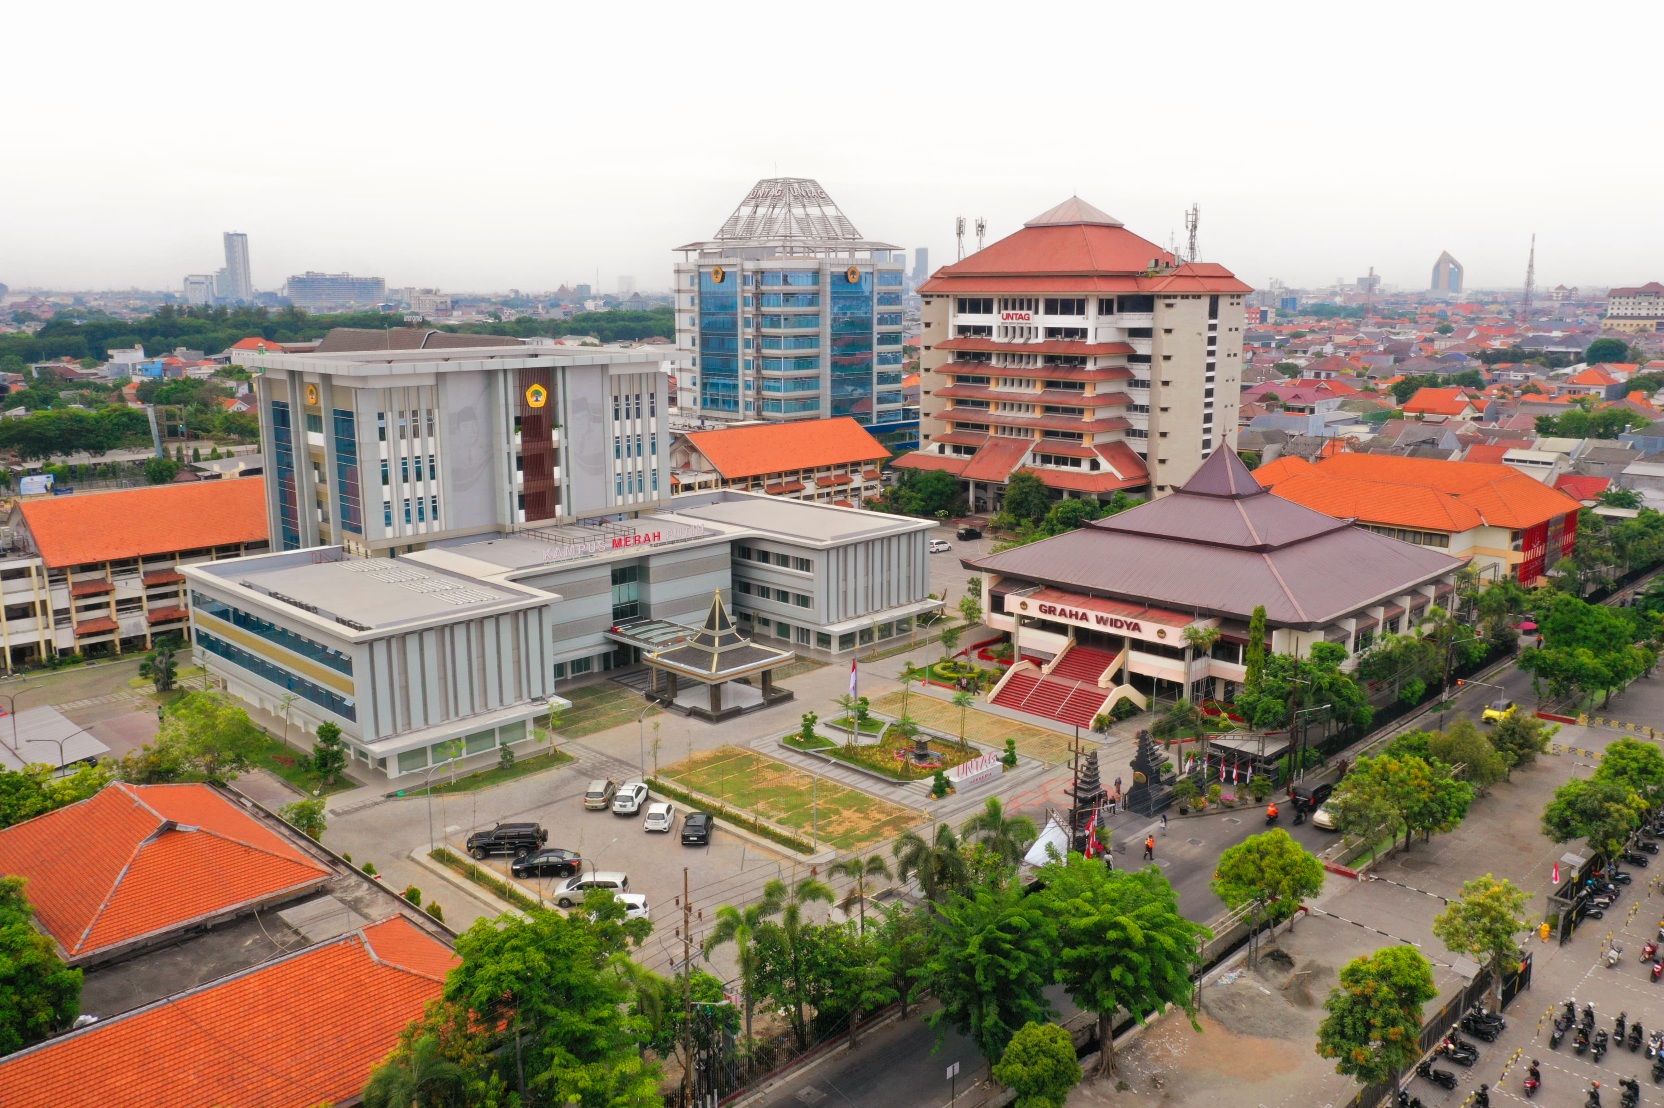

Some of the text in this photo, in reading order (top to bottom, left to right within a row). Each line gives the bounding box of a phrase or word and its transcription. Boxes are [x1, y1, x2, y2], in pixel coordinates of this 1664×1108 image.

[1001, 312, 1031, 321] UNTAG
[543, 523, 704, 561] KAMPUS MERAH PUTIH
[1038, 603, 1142, 632] GRAHA WIDYA
[957, 751, 997, 777] UNTAG
